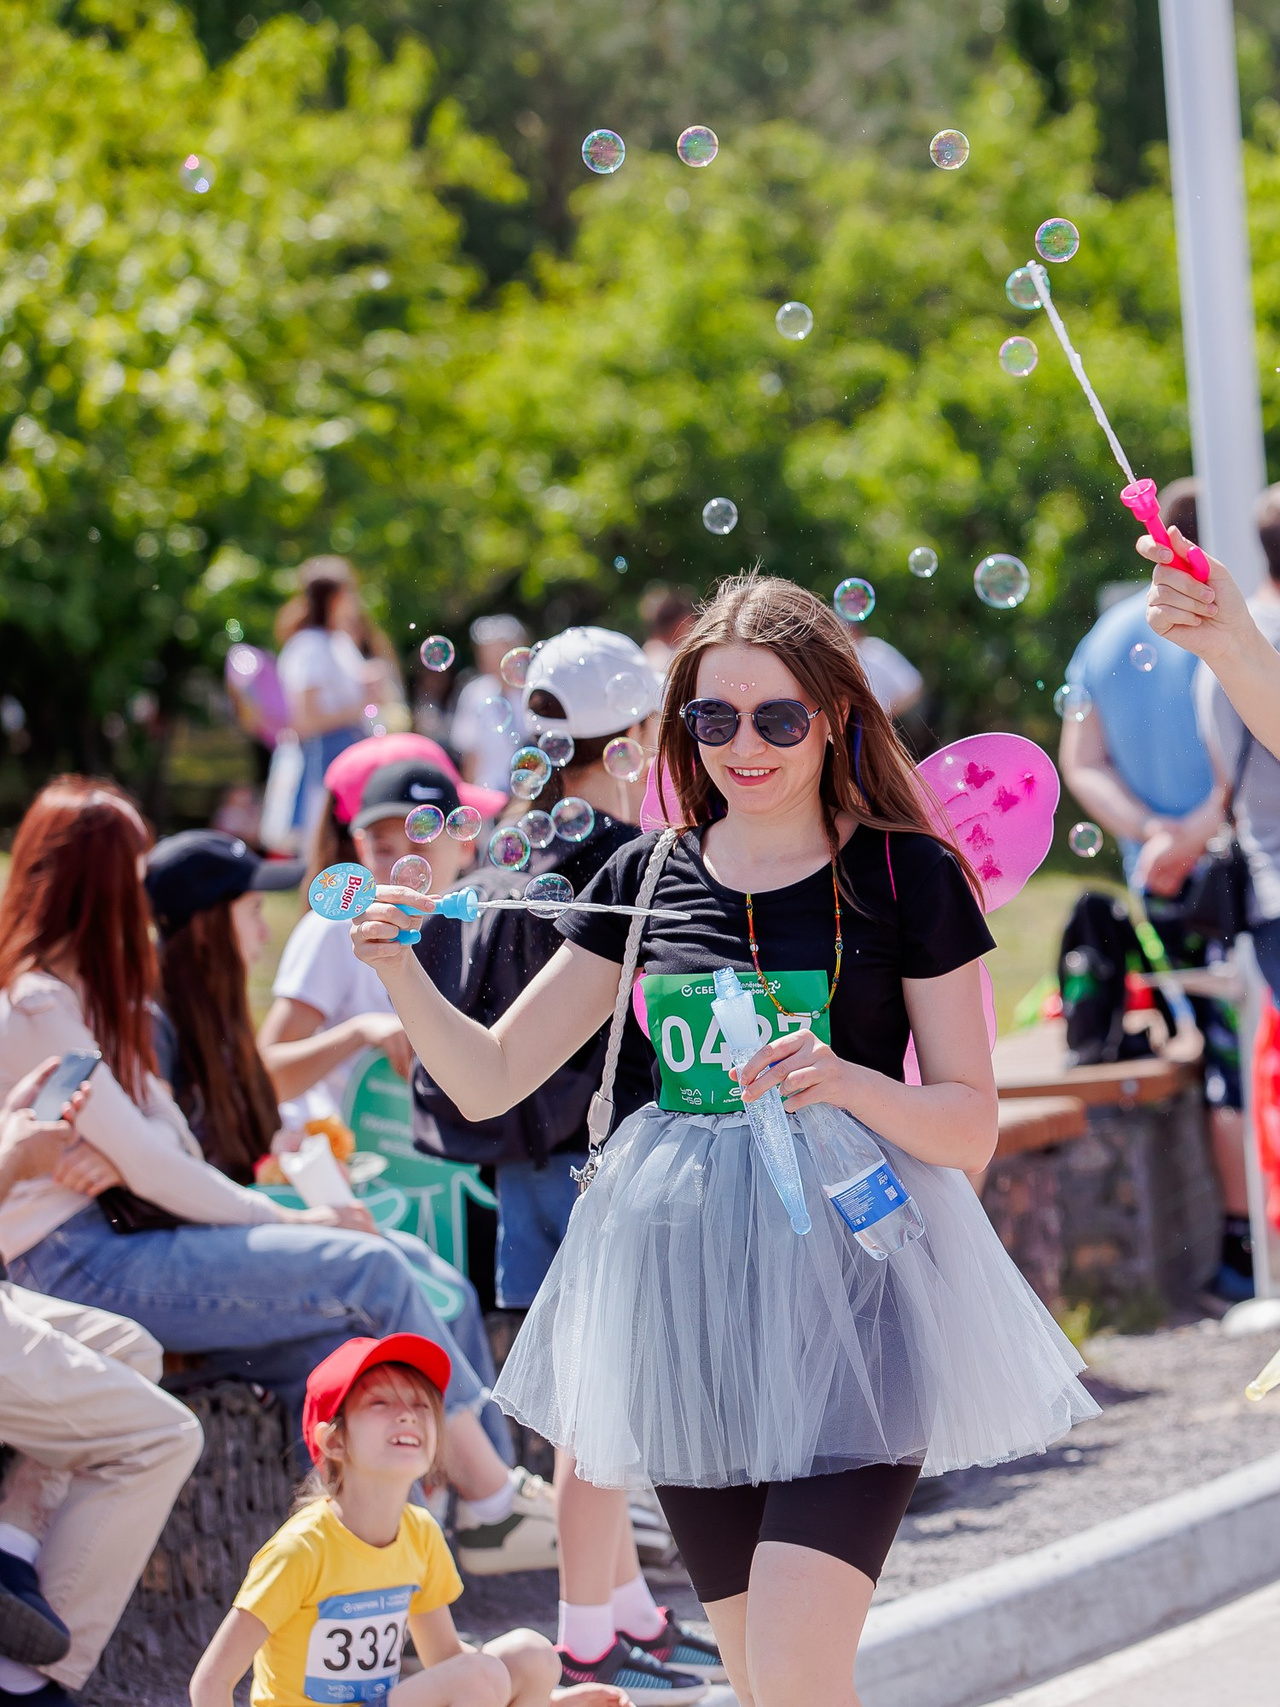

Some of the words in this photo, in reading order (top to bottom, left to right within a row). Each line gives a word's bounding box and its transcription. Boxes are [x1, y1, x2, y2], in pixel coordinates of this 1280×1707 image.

[340, 875, 363, 911] Bigga
[694, 985, 714, 995] СБЕ
[323, 1622, 399, 1671] 332
